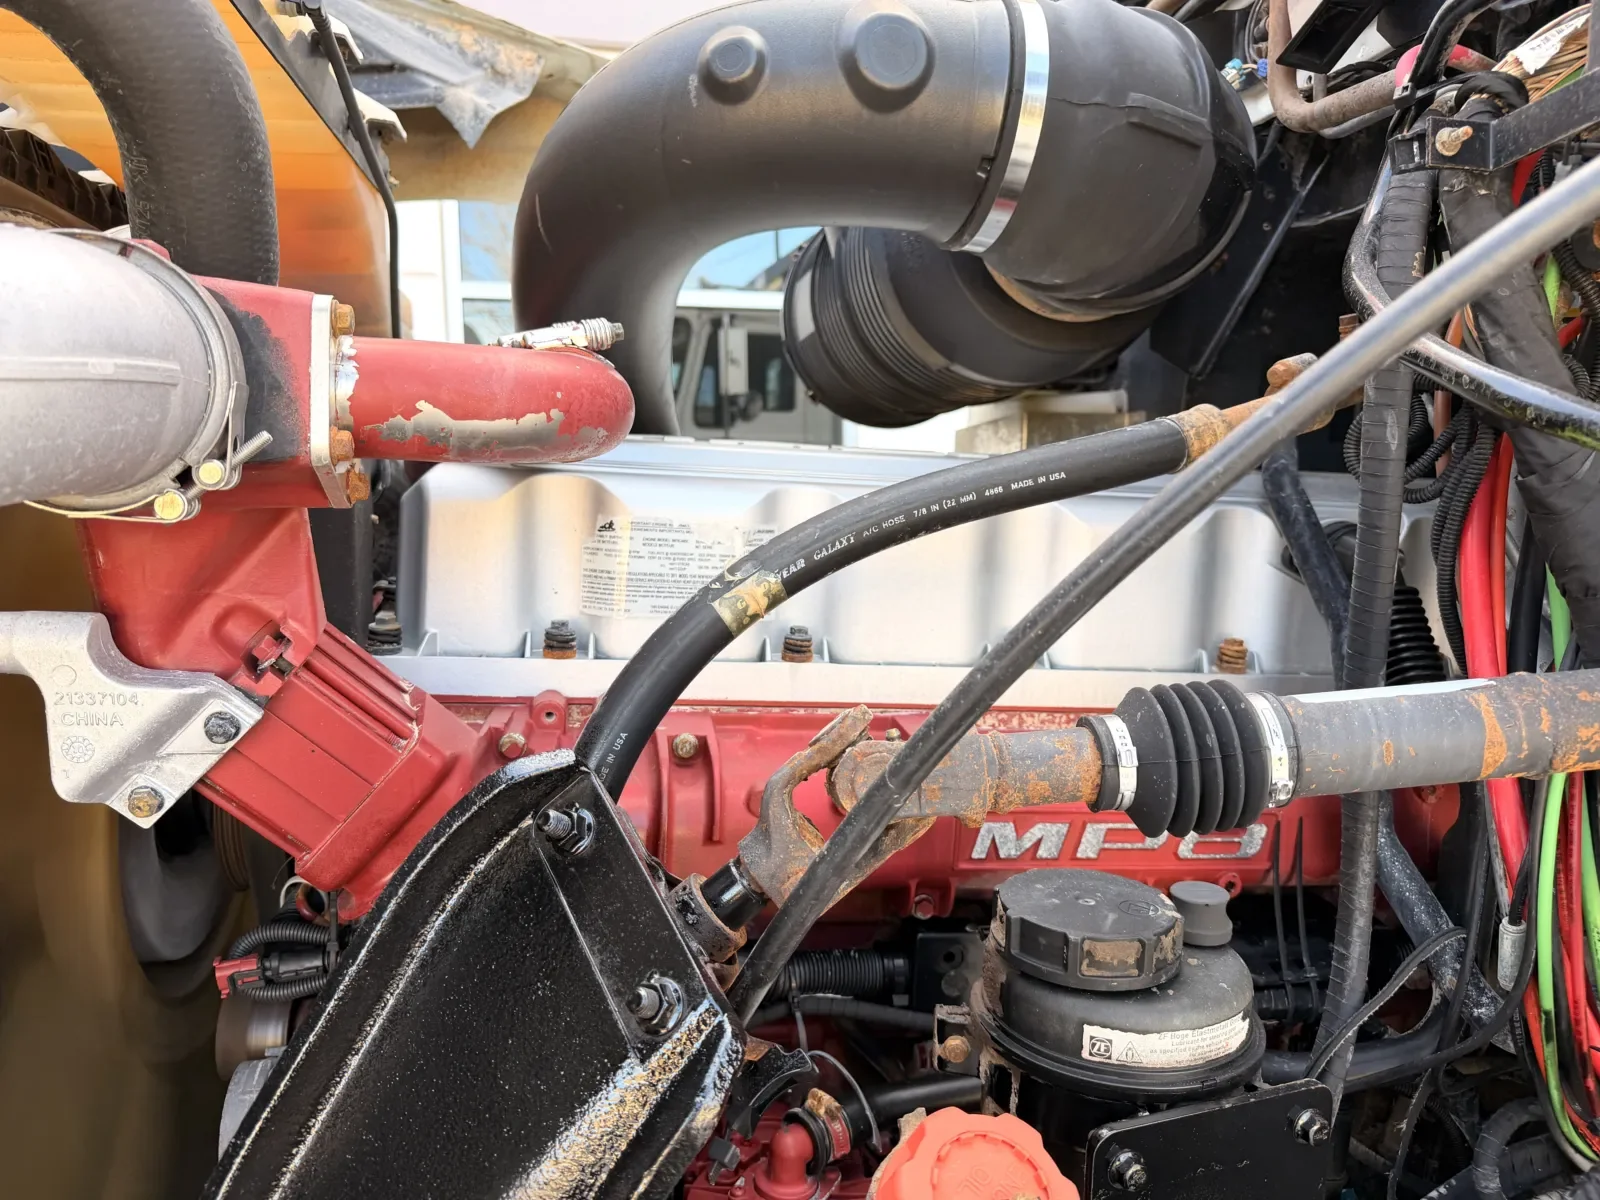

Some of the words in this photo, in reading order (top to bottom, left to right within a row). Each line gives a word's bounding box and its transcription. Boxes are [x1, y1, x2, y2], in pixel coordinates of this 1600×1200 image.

[813, 531, 857, 561] GALAXY
[863, 525, 879, 538] A/C
[882, 514, 906, 530] HOSE
[912, 507, 927, 518] 7/8
[930, 503, 940, 513] IN
[942, 498, 957, 510] (22
[960, 491, 977, 504] MM)
[1010, 478, 1035, 491] MADE
[1037, 474, 1046, 484] IN
[1049, 471, 1067, 481] USA
[53, 691, 139, 706] 21337104
[60, 711, 124, 727] CHINA
[606, 753, 616, 764] IN
[613, 732, 629, 750] USA
[970, 821, 1268, 860] MP8
